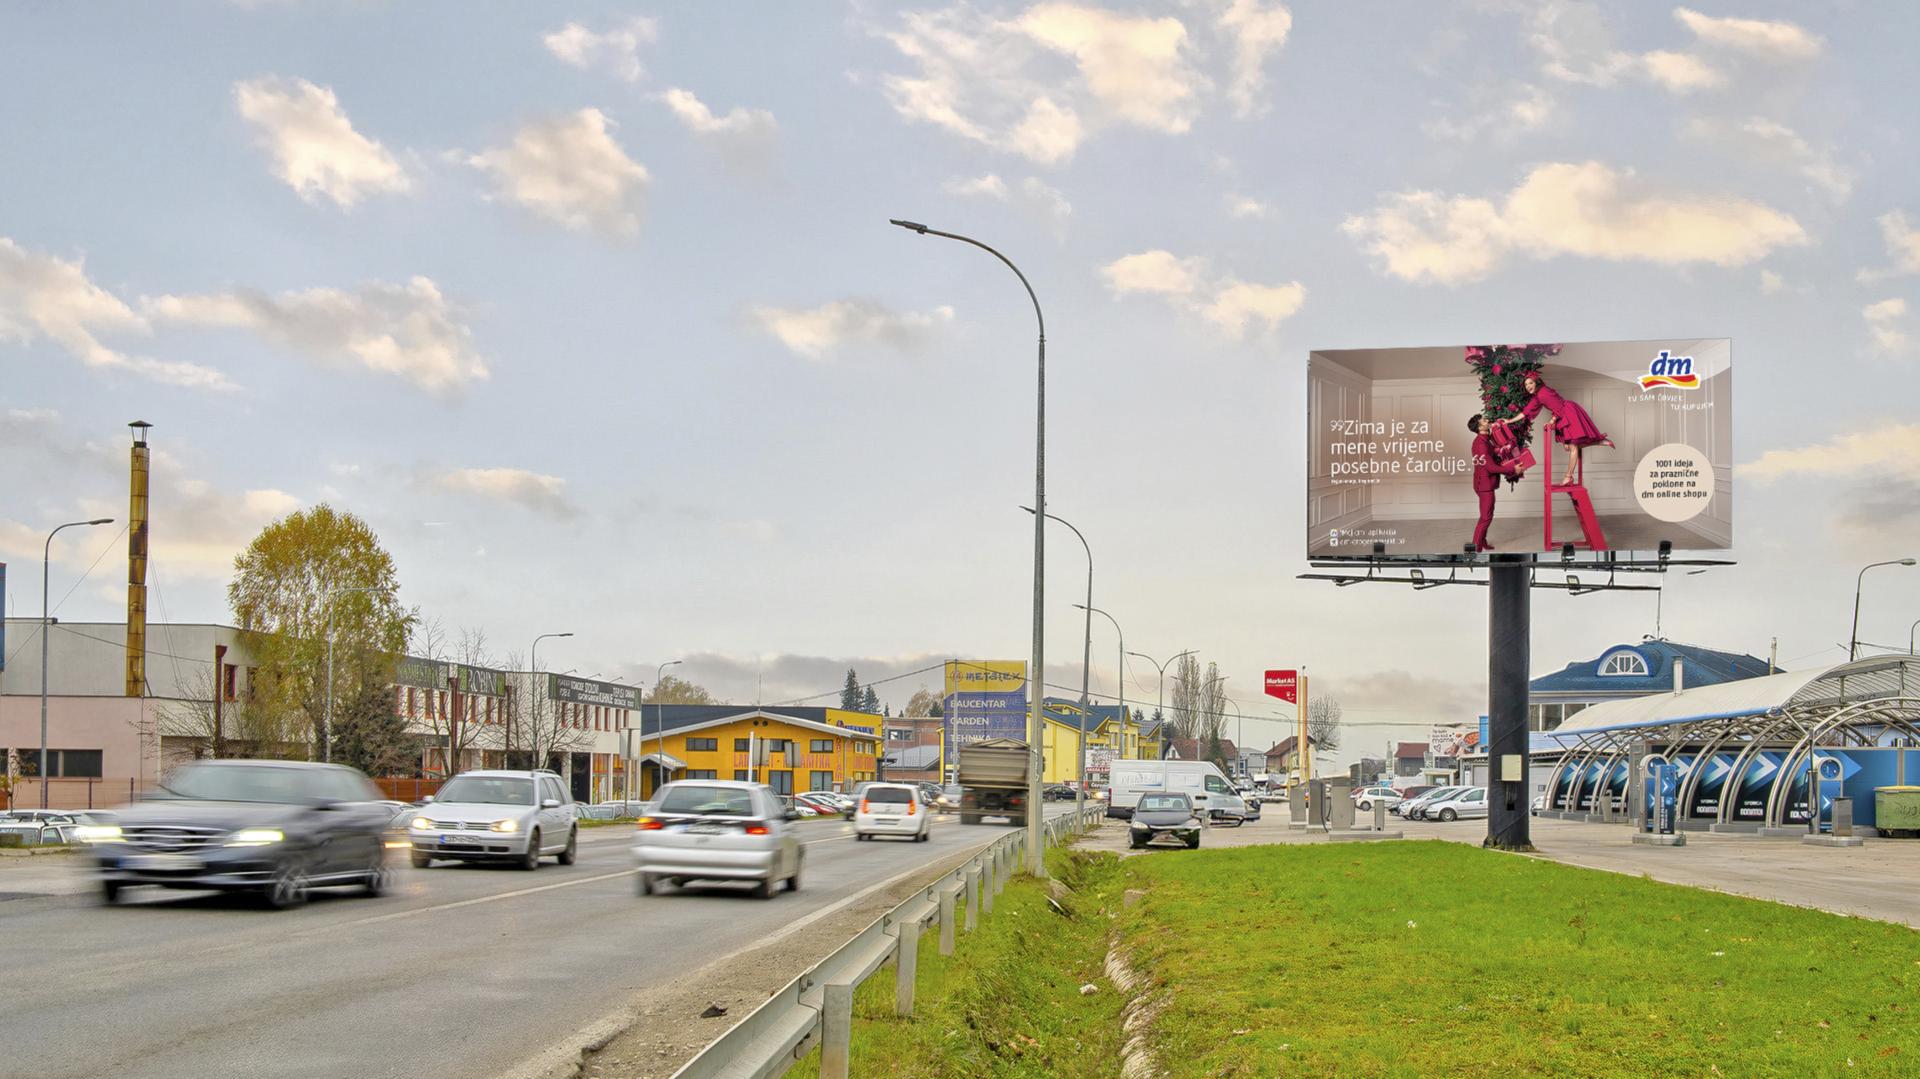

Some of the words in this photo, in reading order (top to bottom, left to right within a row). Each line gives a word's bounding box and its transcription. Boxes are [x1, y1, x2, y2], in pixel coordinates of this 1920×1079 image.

[1651, 352, 1692, 376] dm
[1390, 419, 1406, 438] je
[1410, 421, 1428, 434] za
[1330, 442, 1377, 455] mene
[1382, 438, 1444, 457] vrijeme
[1330, 458, 1400, 478] posebne
[1656, 460, 1672, 468] 1001
[1674, 459, 1694, 468] ideja
[1660, 470, 1699, 478] praznične
[1652, 480, 1684, 489] poklone
[1642, 490, 1654, 498] dm
[1656, 490, 1680, 498] online
[1683, 490, 1707, 498] shopu
[950, 700, 1006, 708] BAUCENTAR
